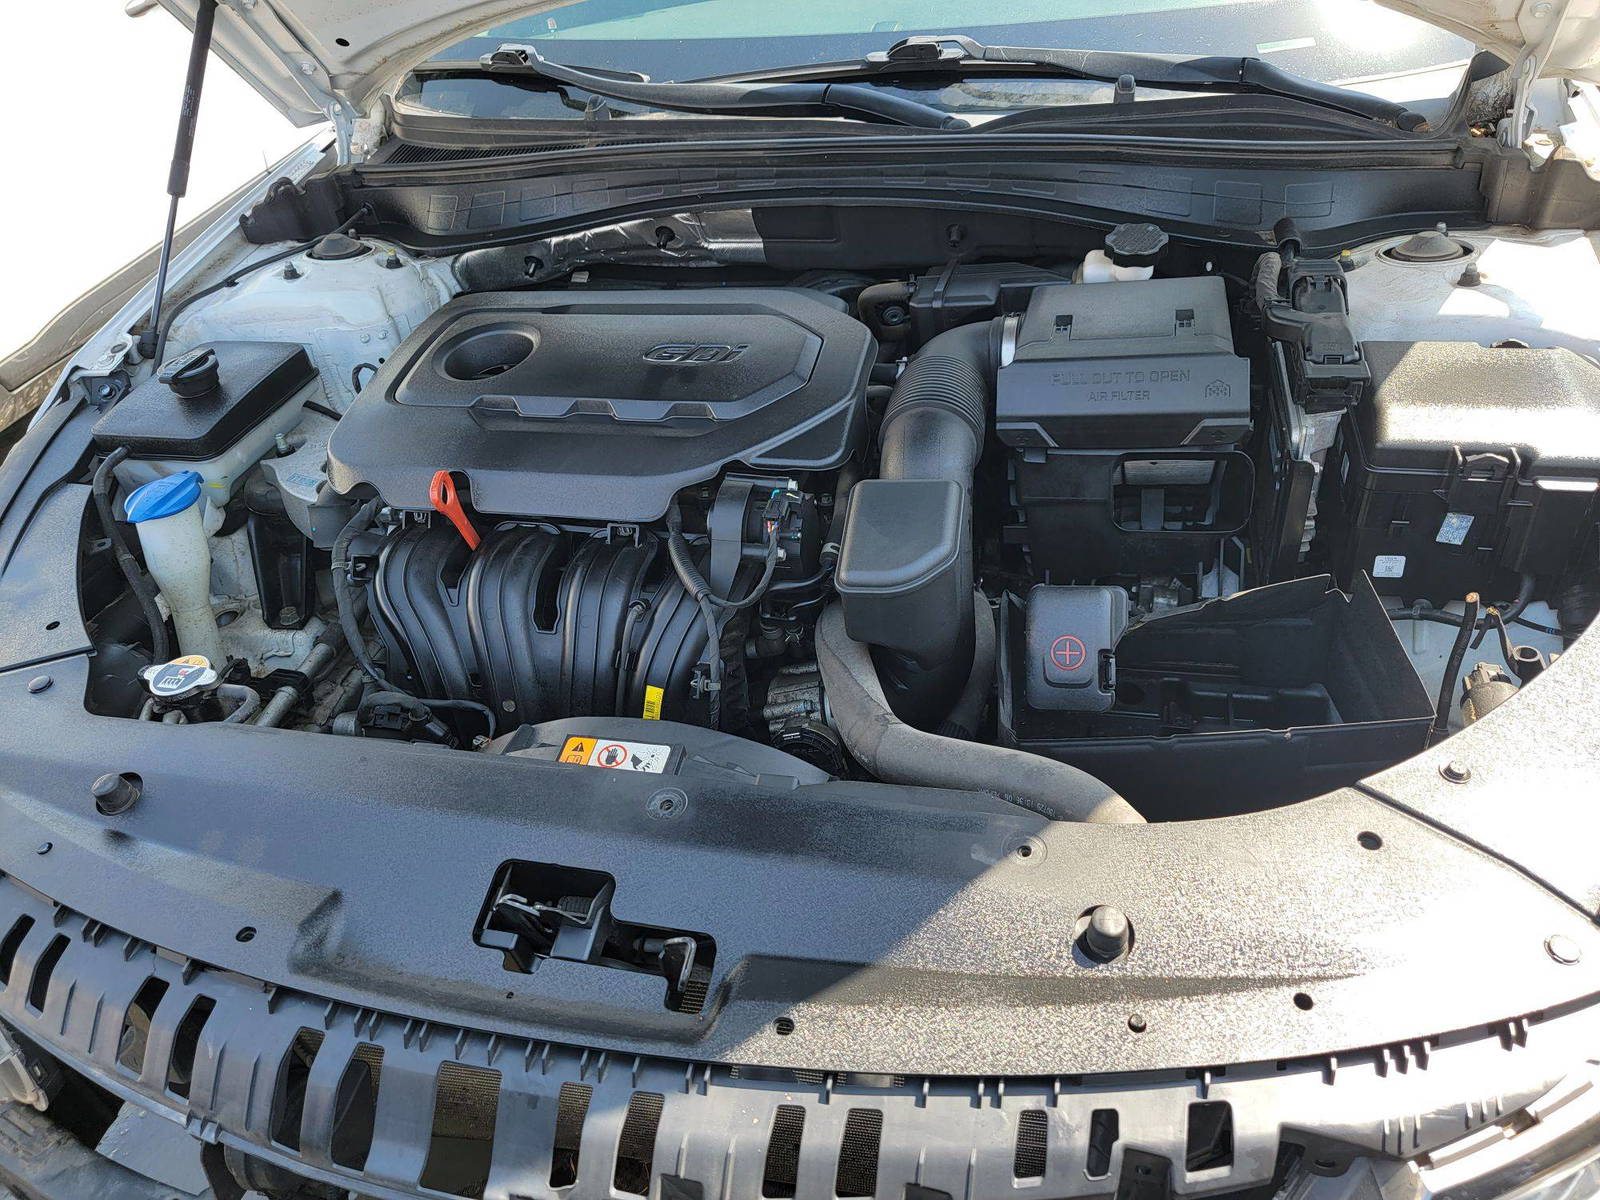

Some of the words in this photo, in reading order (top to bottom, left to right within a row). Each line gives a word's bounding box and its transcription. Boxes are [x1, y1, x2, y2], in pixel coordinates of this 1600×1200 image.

[1093, 372, 1122, 384] OUT
[1127, 371, 1145, 384] TO
[1150, 369, 1191, 383] OPEN
[1088, 391, 1107, 402] AIR
[1111, 390, 1150, 401] FILTER
